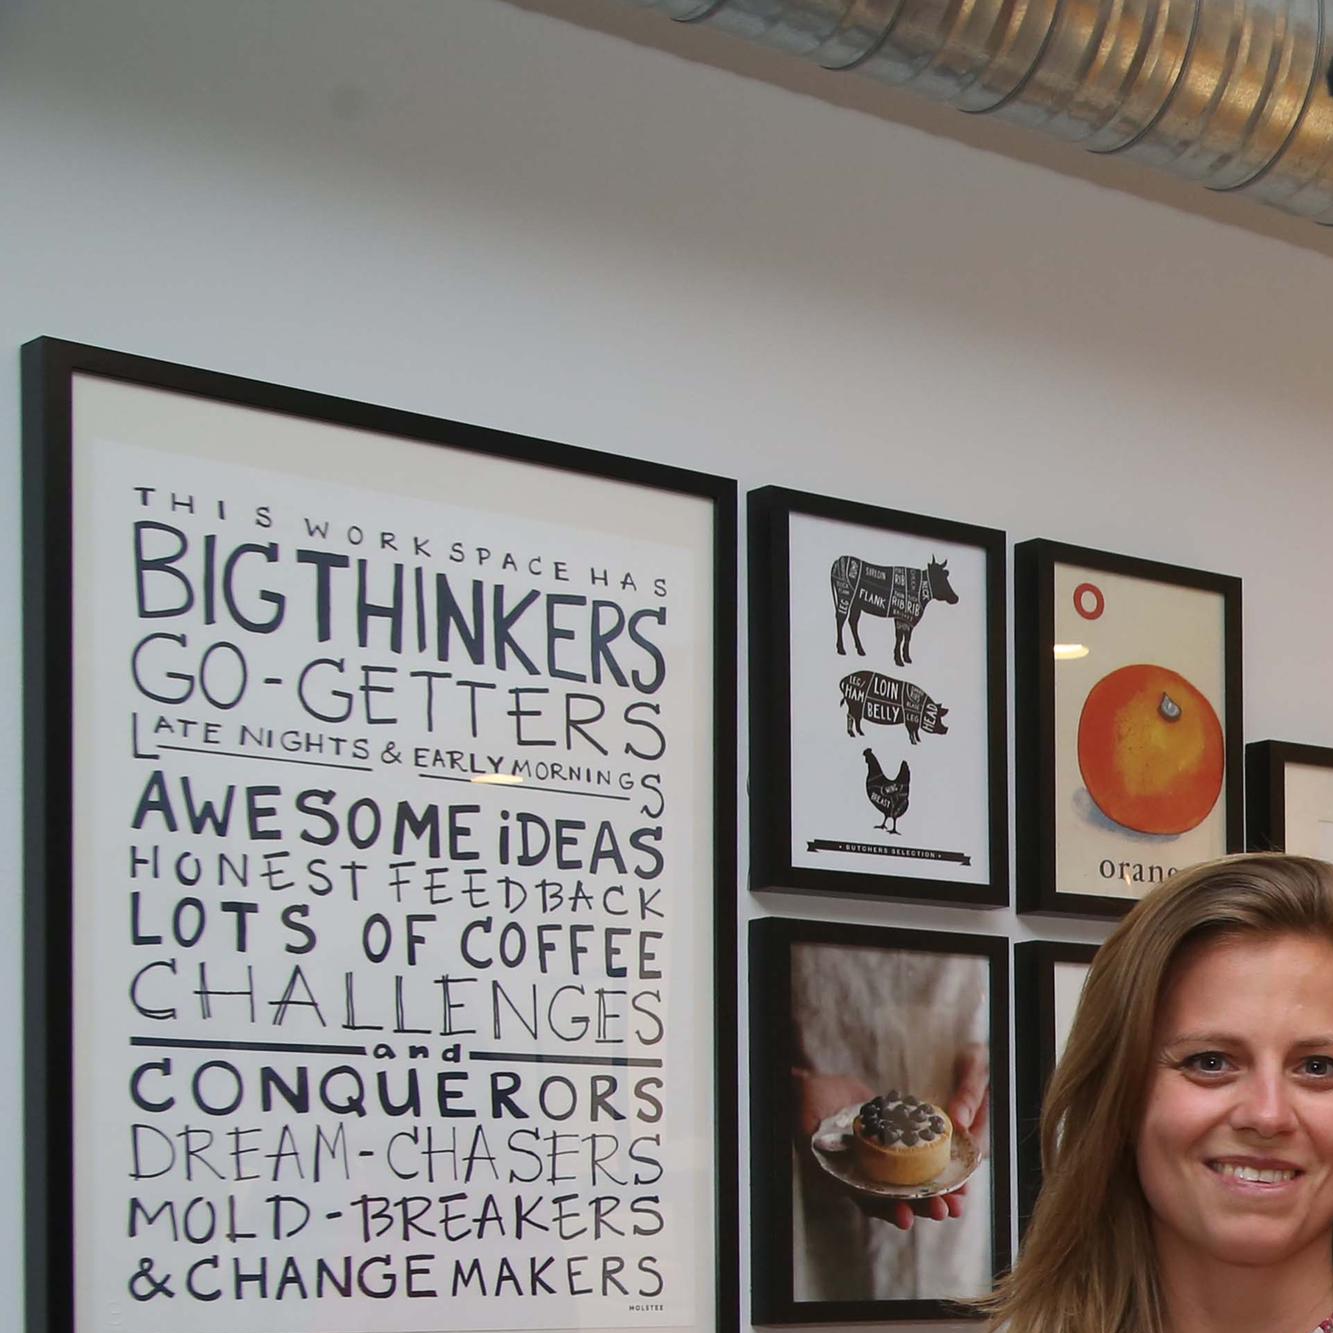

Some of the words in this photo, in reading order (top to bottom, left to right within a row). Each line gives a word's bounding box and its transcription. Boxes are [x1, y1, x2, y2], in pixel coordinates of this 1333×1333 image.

[134, 486, 274, 529] THIS
[591, 566, 668, 598] HAS
[131, 632, 667, 763] GO-GETTERS
[844, 683, 865, 703] HAM
[866, 701, 901, 723] BELLY
[873, 676, 899, 701] LOIN
[921, 702, 939, 732] HEAD
[131, 711, 222, 761] LATE
[240, 725, 371, 761] NIGHTS
[380, 741, 403, 765] &
[416, 745, 504, 777] EARLY
[511, 759, 666, 819] MORNINGS
[131, 770, 481, 861] AWESOME
[130, 845, 369, 902] HONEST
[389, 862, 665, 919] FEEDBACK
[130, 890, 318, 954] LOTS
[362, 911, 437, 967] OF
[460, 916, 664, 980] COFFEE
[129, 958, 664, 1046] CHALLENGES
[372, 1041, 463, 1064] and
[129, 1058, 665, 1125] CONQUERORS
[128, 1121, 664, 1187] DREAM-CHASERS
[128, 1192, 665, 1244] MOLD-BREAKERS
